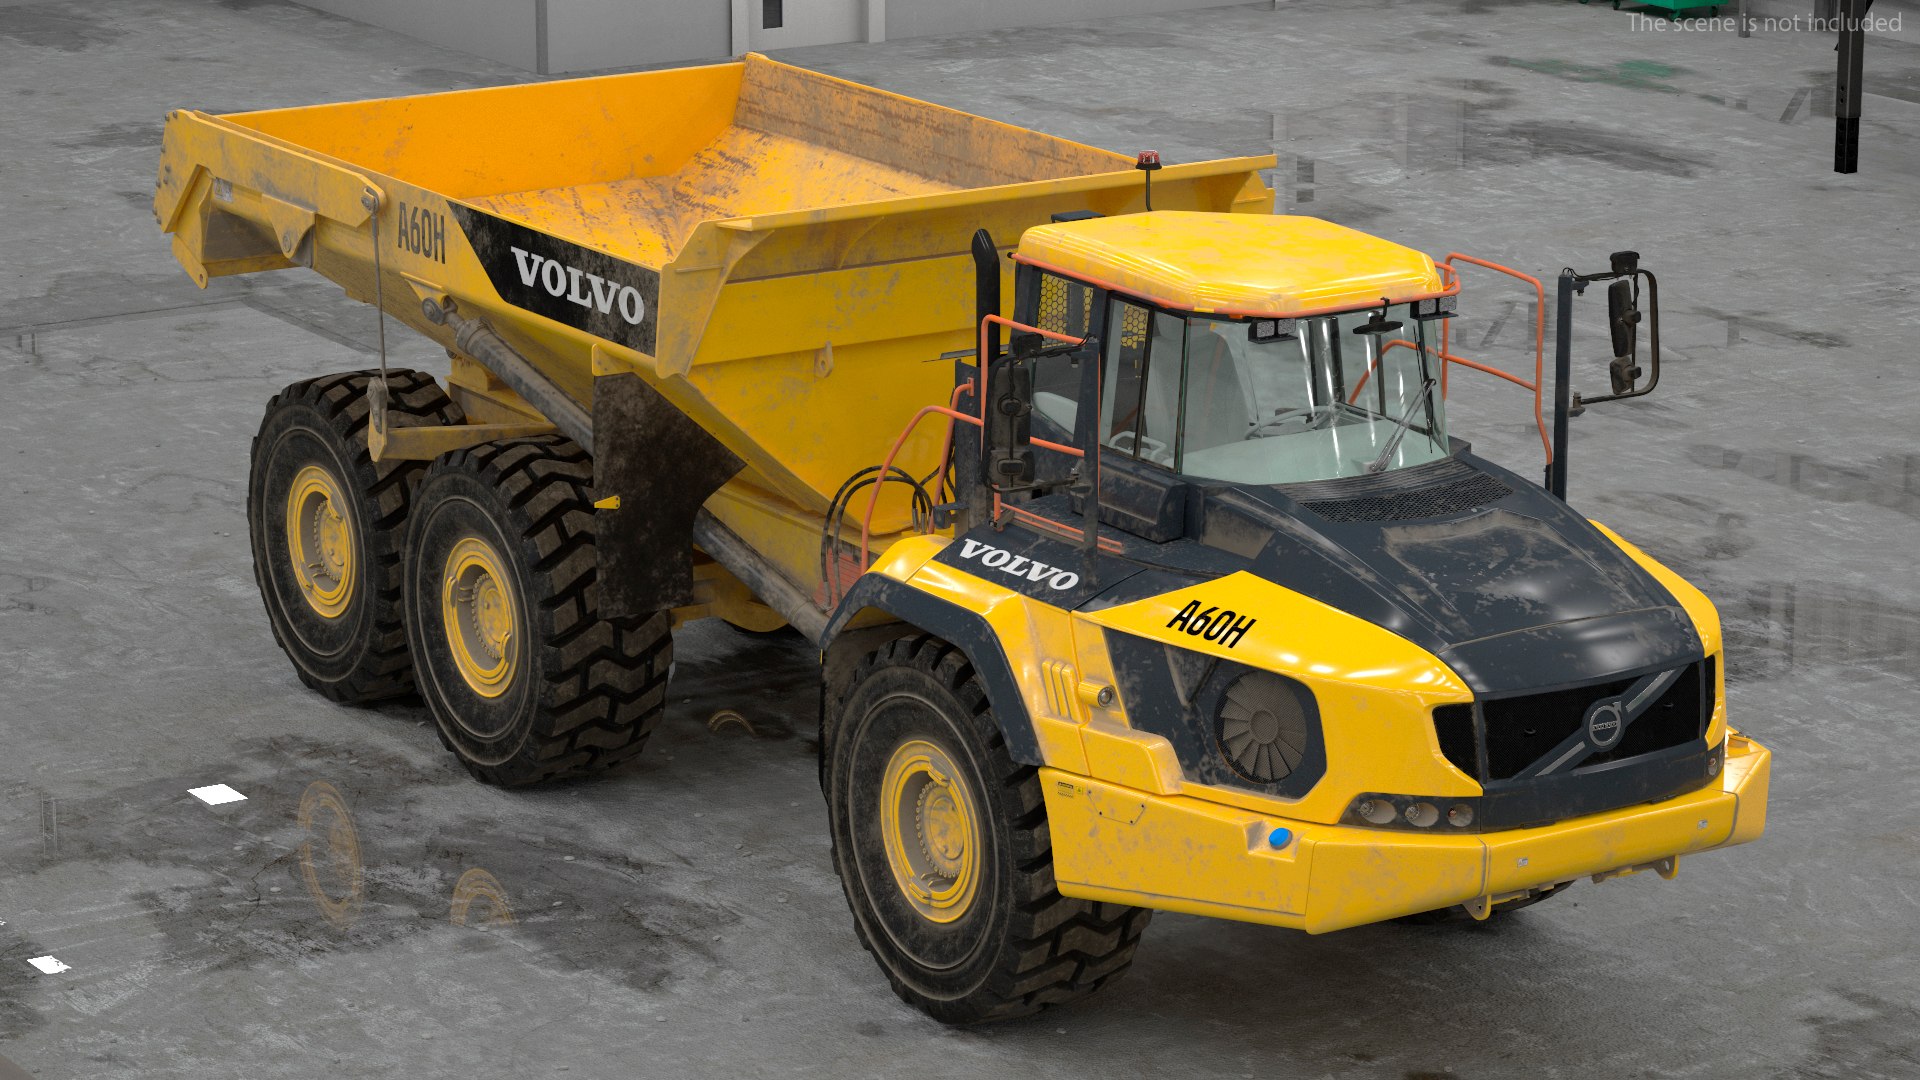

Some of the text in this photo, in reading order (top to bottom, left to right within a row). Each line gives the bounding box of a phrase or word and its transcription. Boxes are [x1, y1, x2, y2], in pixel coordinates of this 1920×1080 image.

[397, 201, 446, 265] A60H
[510, 245, 645, 325] VOLVO
[958, 538, 1080, 591] VOLVO
[1166, 599, 1257, 649] A60H
